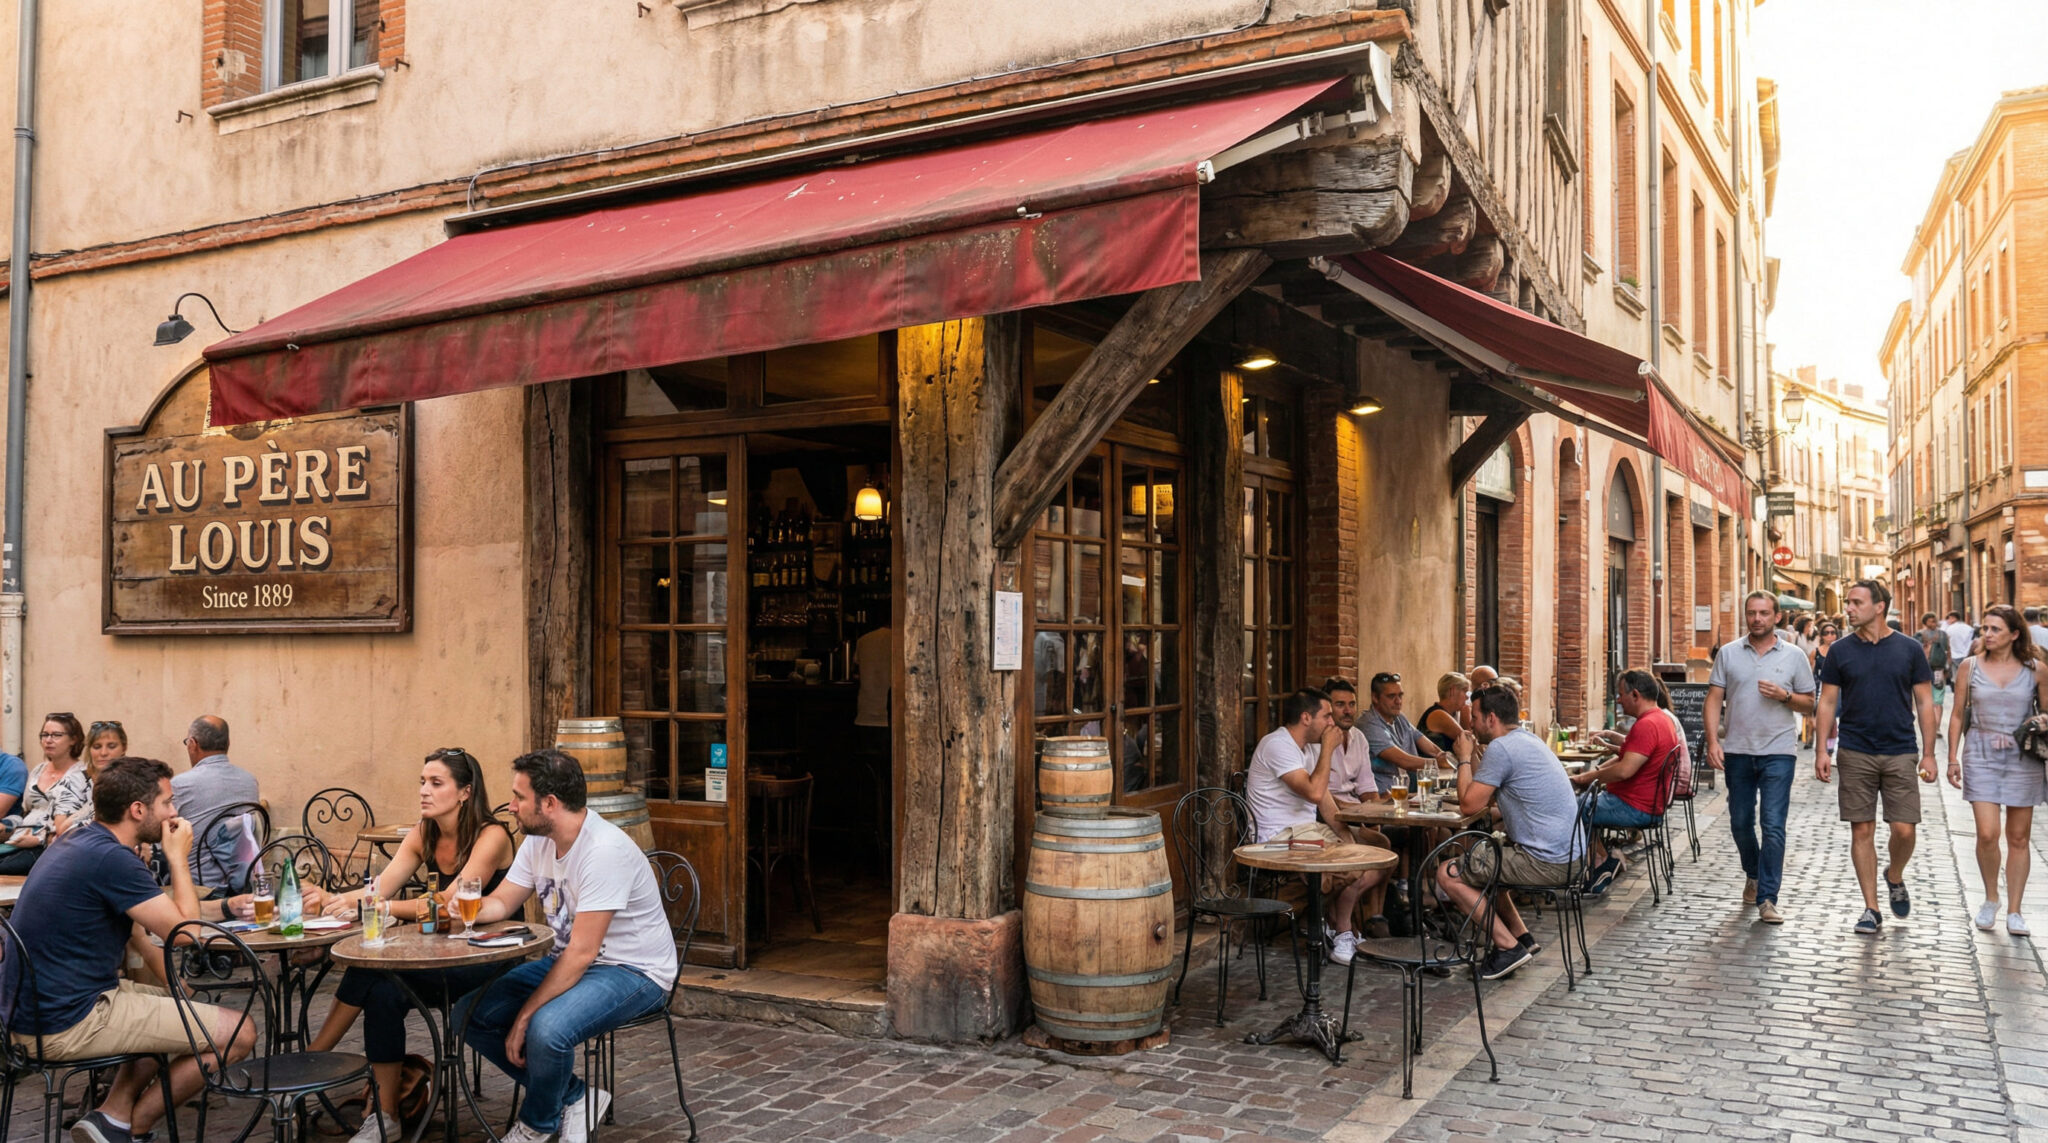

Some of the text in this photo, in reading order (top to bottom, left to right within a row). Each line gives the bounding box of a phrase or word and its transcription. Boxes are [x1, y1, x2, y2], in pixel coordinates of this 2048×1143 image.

[136, 439, 368, 511] AU PÈRE
[168, 515, 330, 571] LOUIS
[202, 583, 293, 609] Since 1889
